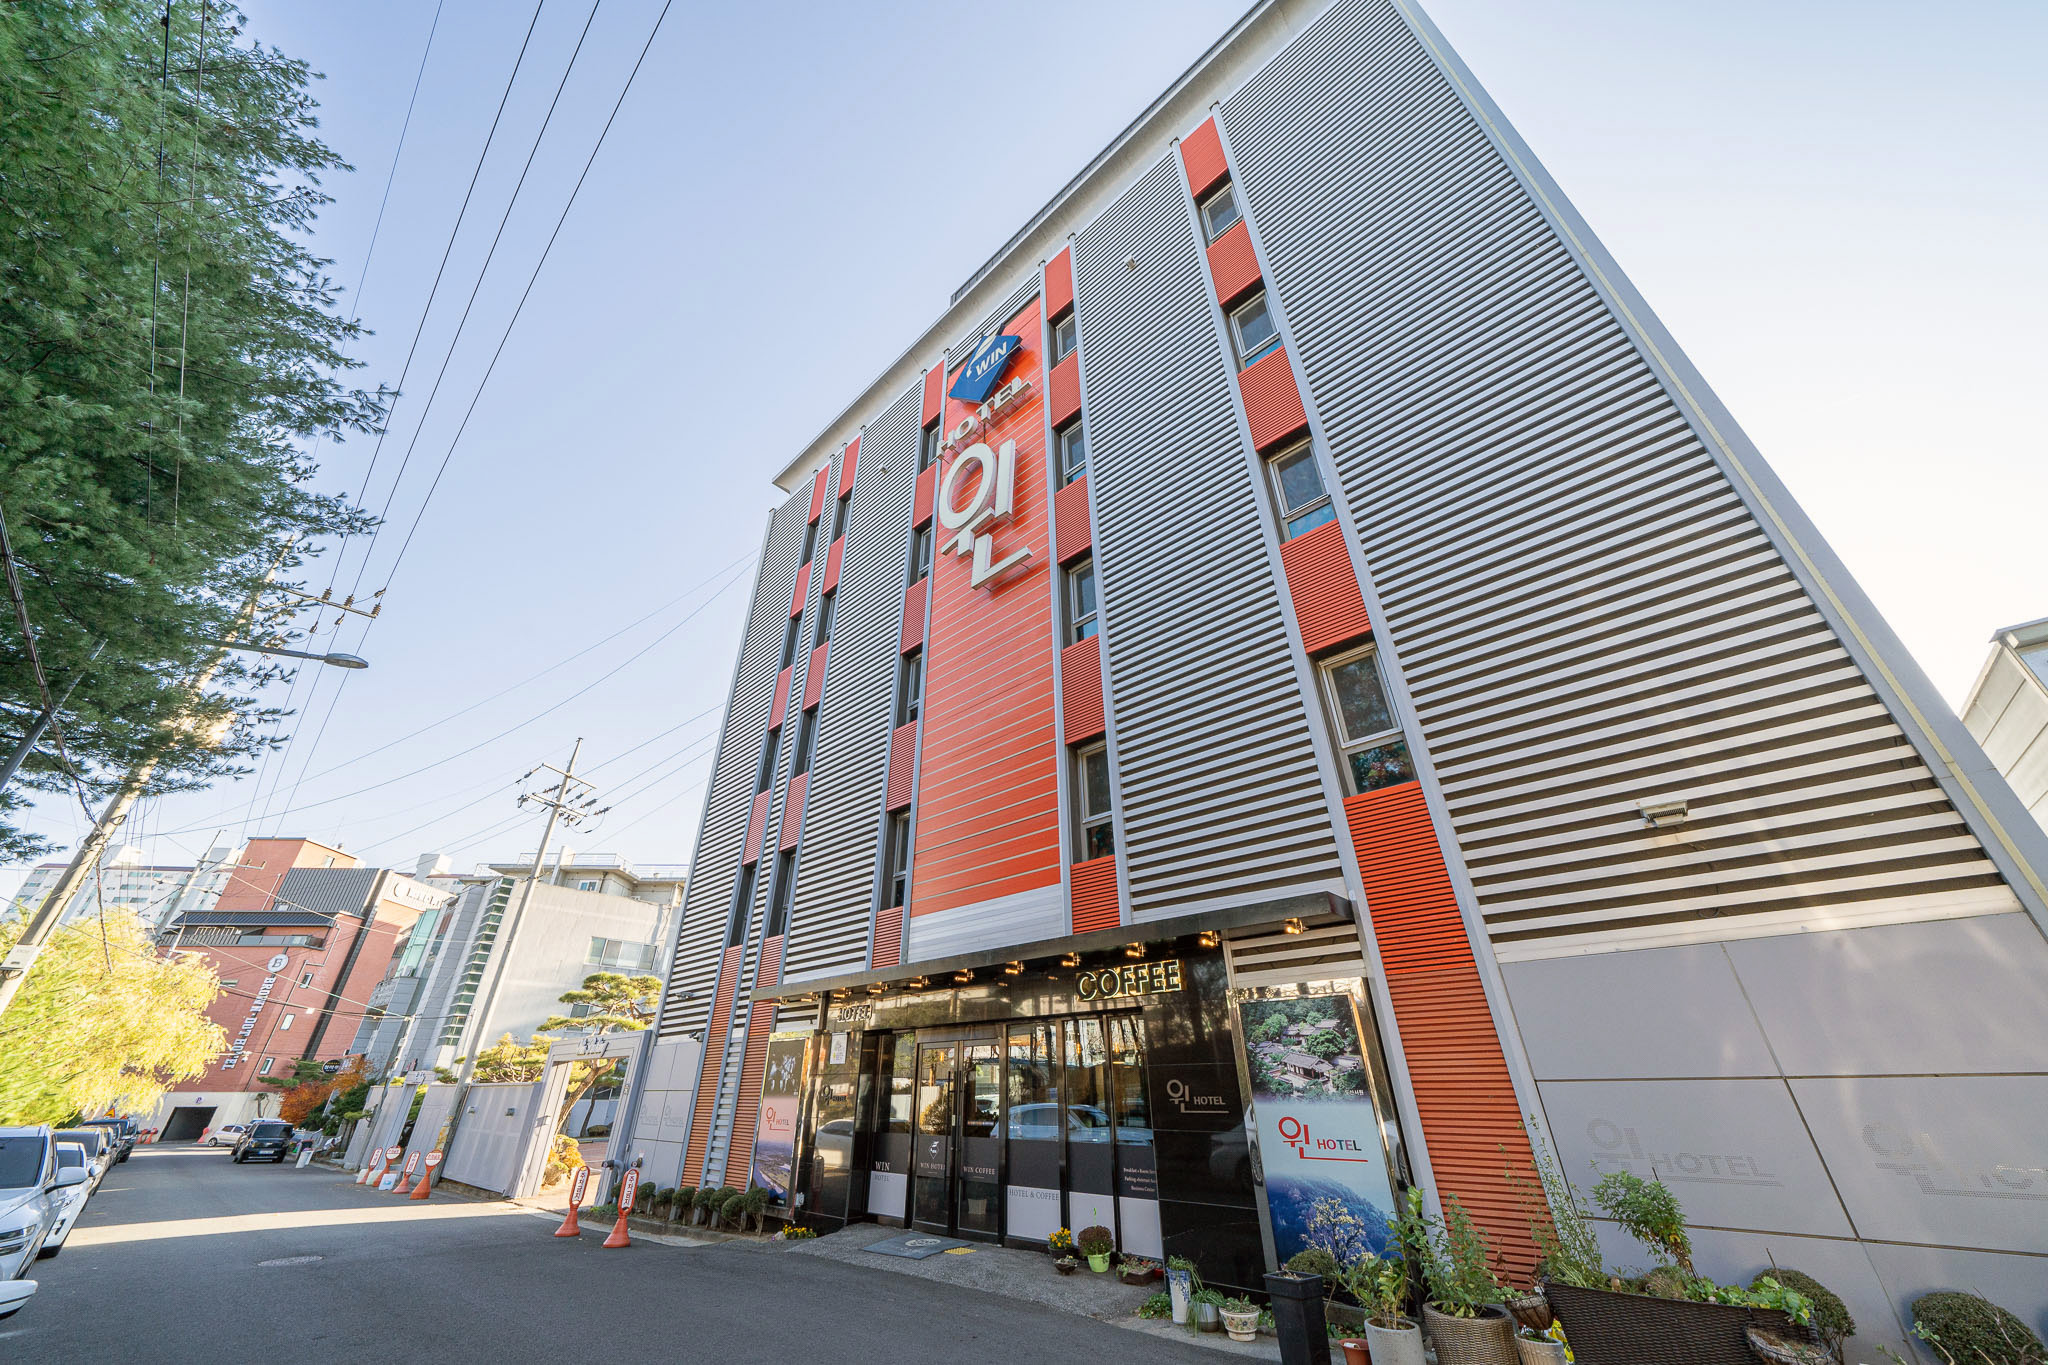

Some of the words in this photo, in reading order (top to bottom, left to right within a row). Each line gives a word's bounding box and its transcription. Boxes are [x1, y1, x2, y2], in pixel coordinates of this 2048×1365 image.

[974, 340, 1008, 376] WIN
[936, 376, 1032, 461] HOTEL
[939, 438, 1033, 591] 윈
[1076, 959, 1182, 1001] COFFEE
[1193, 1096, 1226, 1105] HOTEL
[1316, 1138, 1362, 1152] HOTEL
[875, 1161, 891, 1172] WIN
[974, 1167, 995, 1175] COFFEE
[1650, 1152, 1777, 1178] HOTEL
[874, 1174, 889, 1182] HOTEL
[624, 1175, 635, 1205] 주차금지
[1009, 1187, 1029, 1198] HOTEL
[1030, 1189, 1035, 1198] &
[1036, 1190, 1060, 1200] COFFEE
